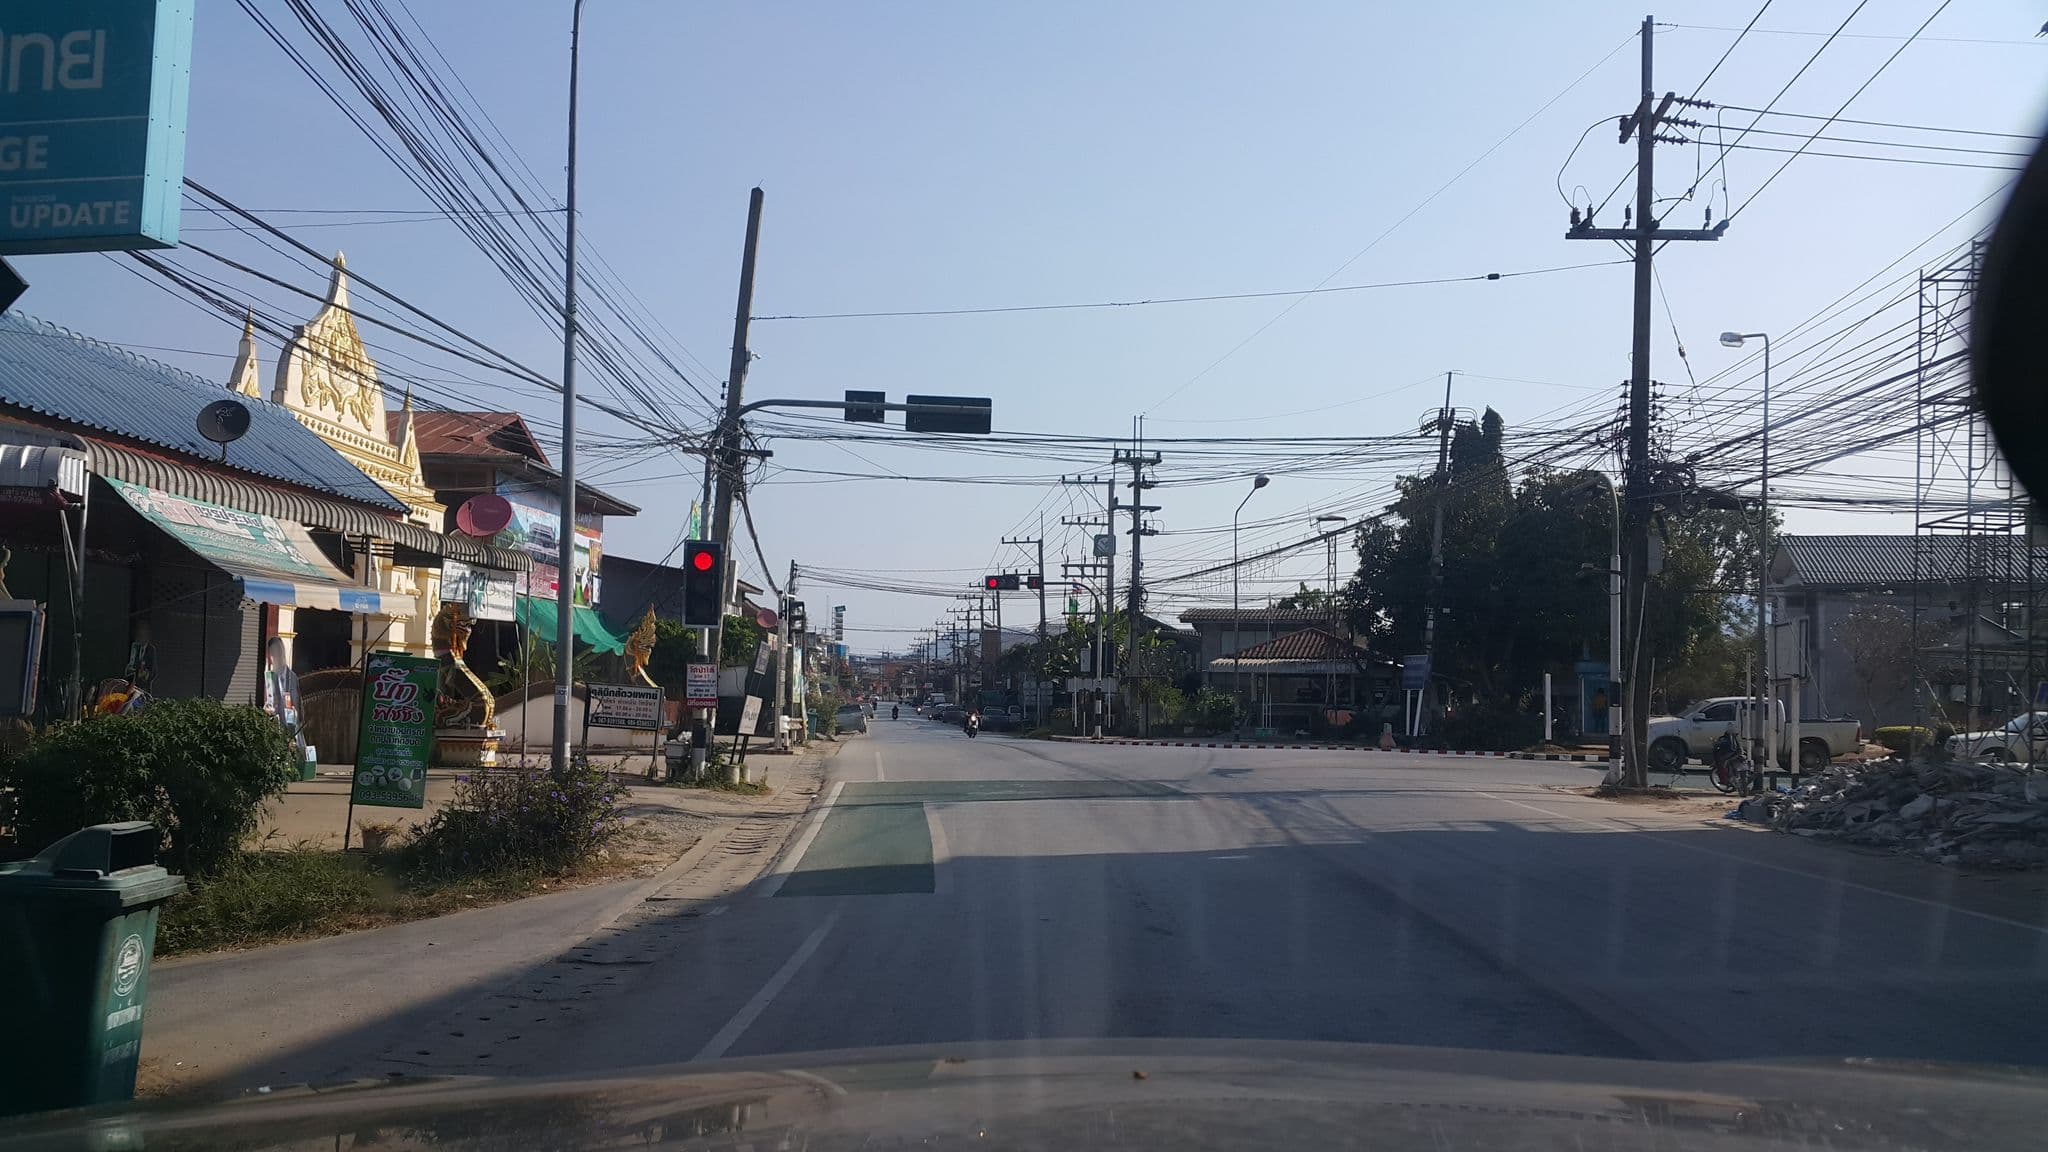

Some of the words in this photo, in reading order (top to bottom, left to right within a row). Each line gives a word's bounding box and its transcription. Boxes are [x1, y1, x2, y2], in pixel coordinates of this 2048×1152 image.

[0, 29, 105, 92] ทย
[10, 200, 130, 228] UPDATE
[591, 687, 659, 700] คลินิกสัตวแพทย์
